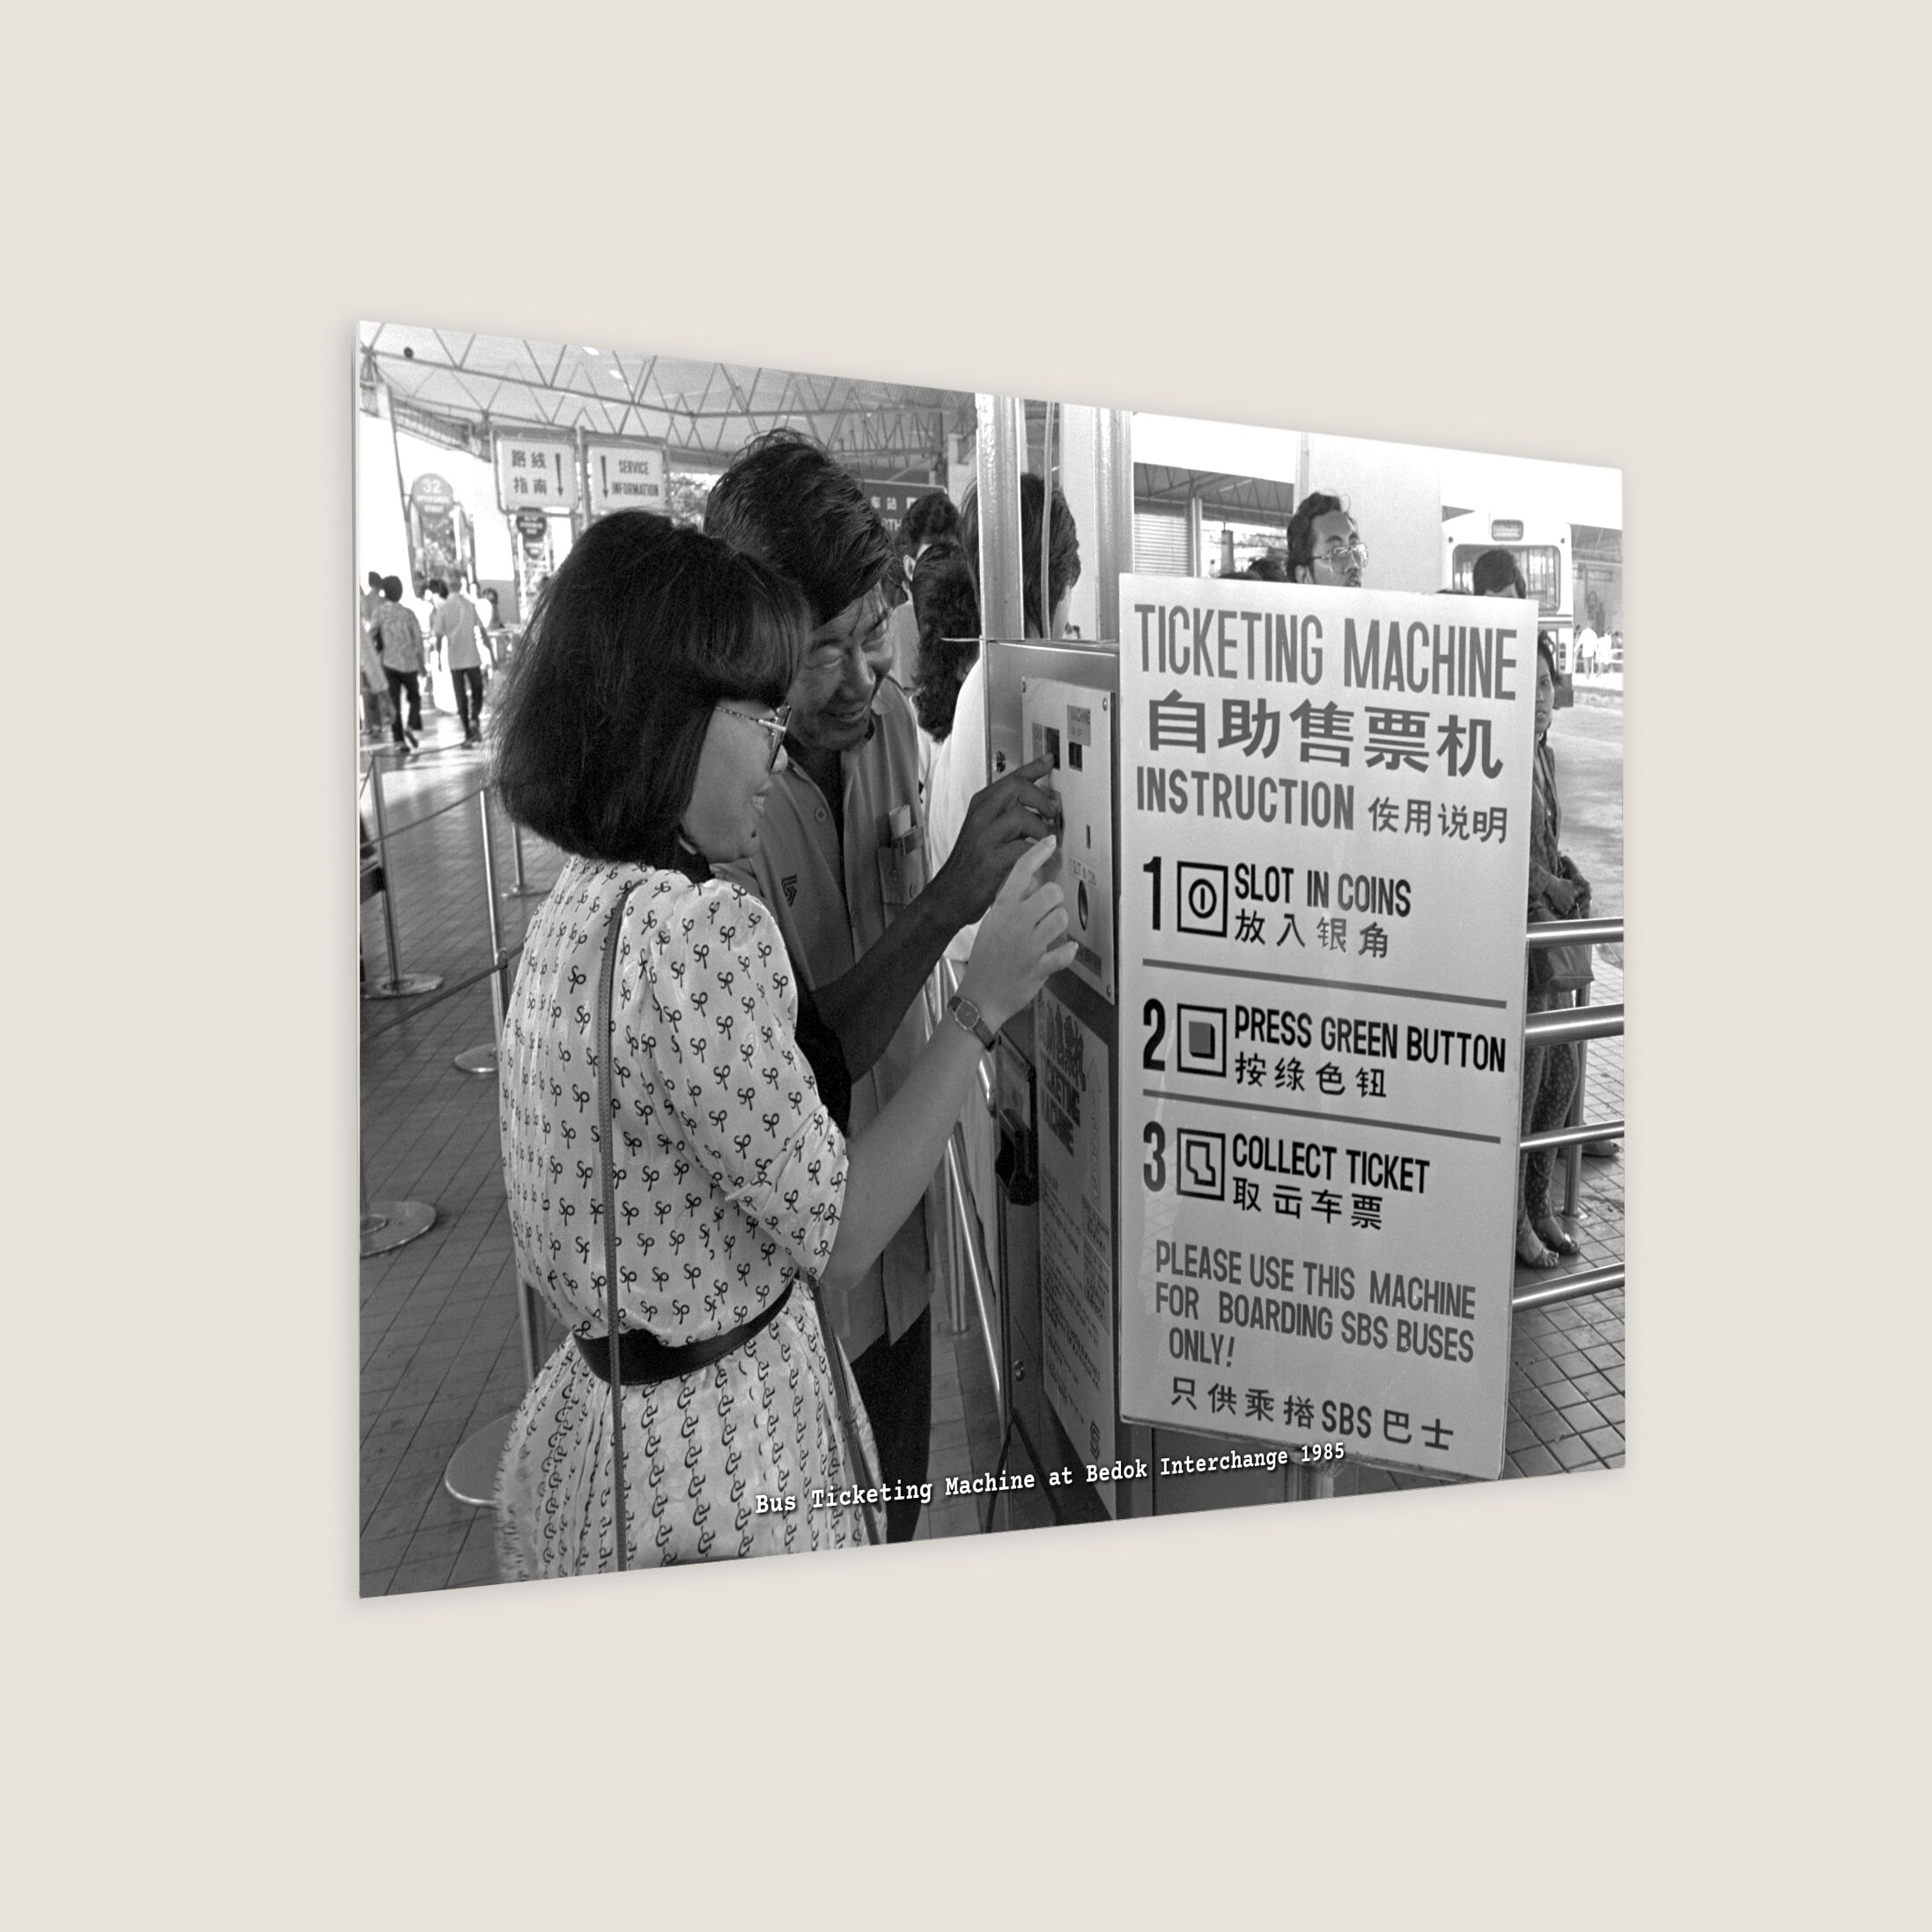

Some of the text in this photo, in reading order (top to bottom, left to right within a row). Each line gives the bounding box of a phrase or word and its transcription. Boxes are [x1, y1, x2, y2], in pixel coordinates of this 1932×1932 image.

[611, 482, 659, 497] INFORMATION
[619, 460, 649, 476] SERVICE
[1134, 603, 1517, 701] TICKETING MACHINE
[1148, 689, 1503, 779] 自助售票机
[1137, 766, 1354, 830] INSTRUCTION
[1143, 856, 1161, 931] 1
[1235, 862, 1412, 918] SLOT IN COINS
[1235, 909, 1389, 958] 放入银角
[1142, 999, 1166, 1072] 2
[1235, 1005, 1507, 1073] PRESS GREEN BUTTON
[1235, 1051, 1387, 1098] 按绿色钮
[1143, 1121, 1166, 1192] 3
[1233, 1133, 1430, 1194] COLLECT TICKET
[1155, 1240, 1476, 1320] PLEASE USE THIS MACHINE
[1155, 1282, 1474, 1363] FOR BOARDING SBS BUSES
[1169, 1327, 1235, 1368] ONLY!
